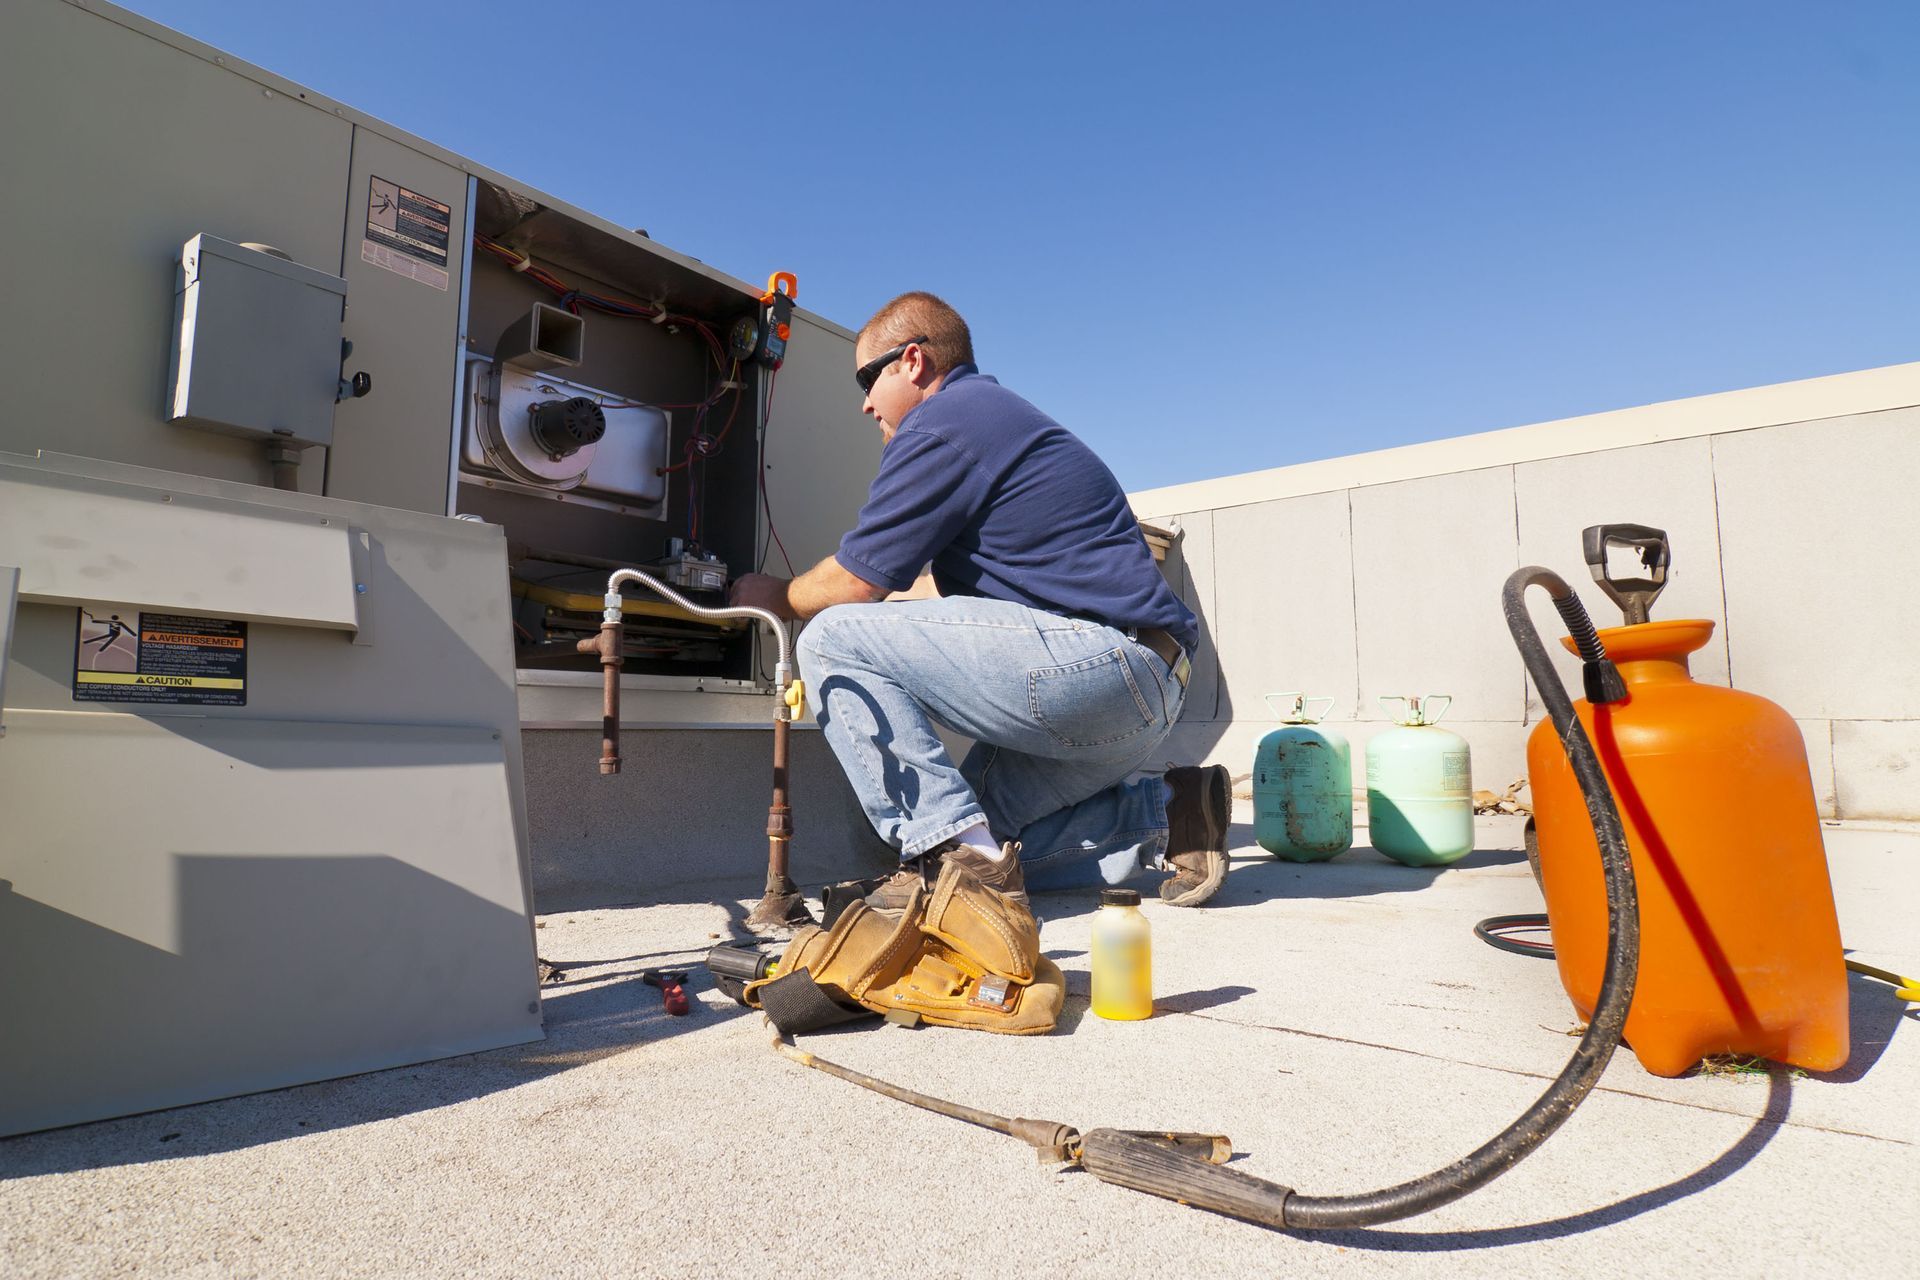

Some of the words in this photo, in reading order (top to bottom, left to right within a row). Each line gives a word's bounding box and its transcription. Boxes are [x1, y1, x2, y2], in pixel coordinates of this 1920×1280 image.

[399, 235, 422, 247] CAUTION
[158, 634, 239, 646] AVERTISSEMENT
[146, 676, 192, 686] CAUTION
